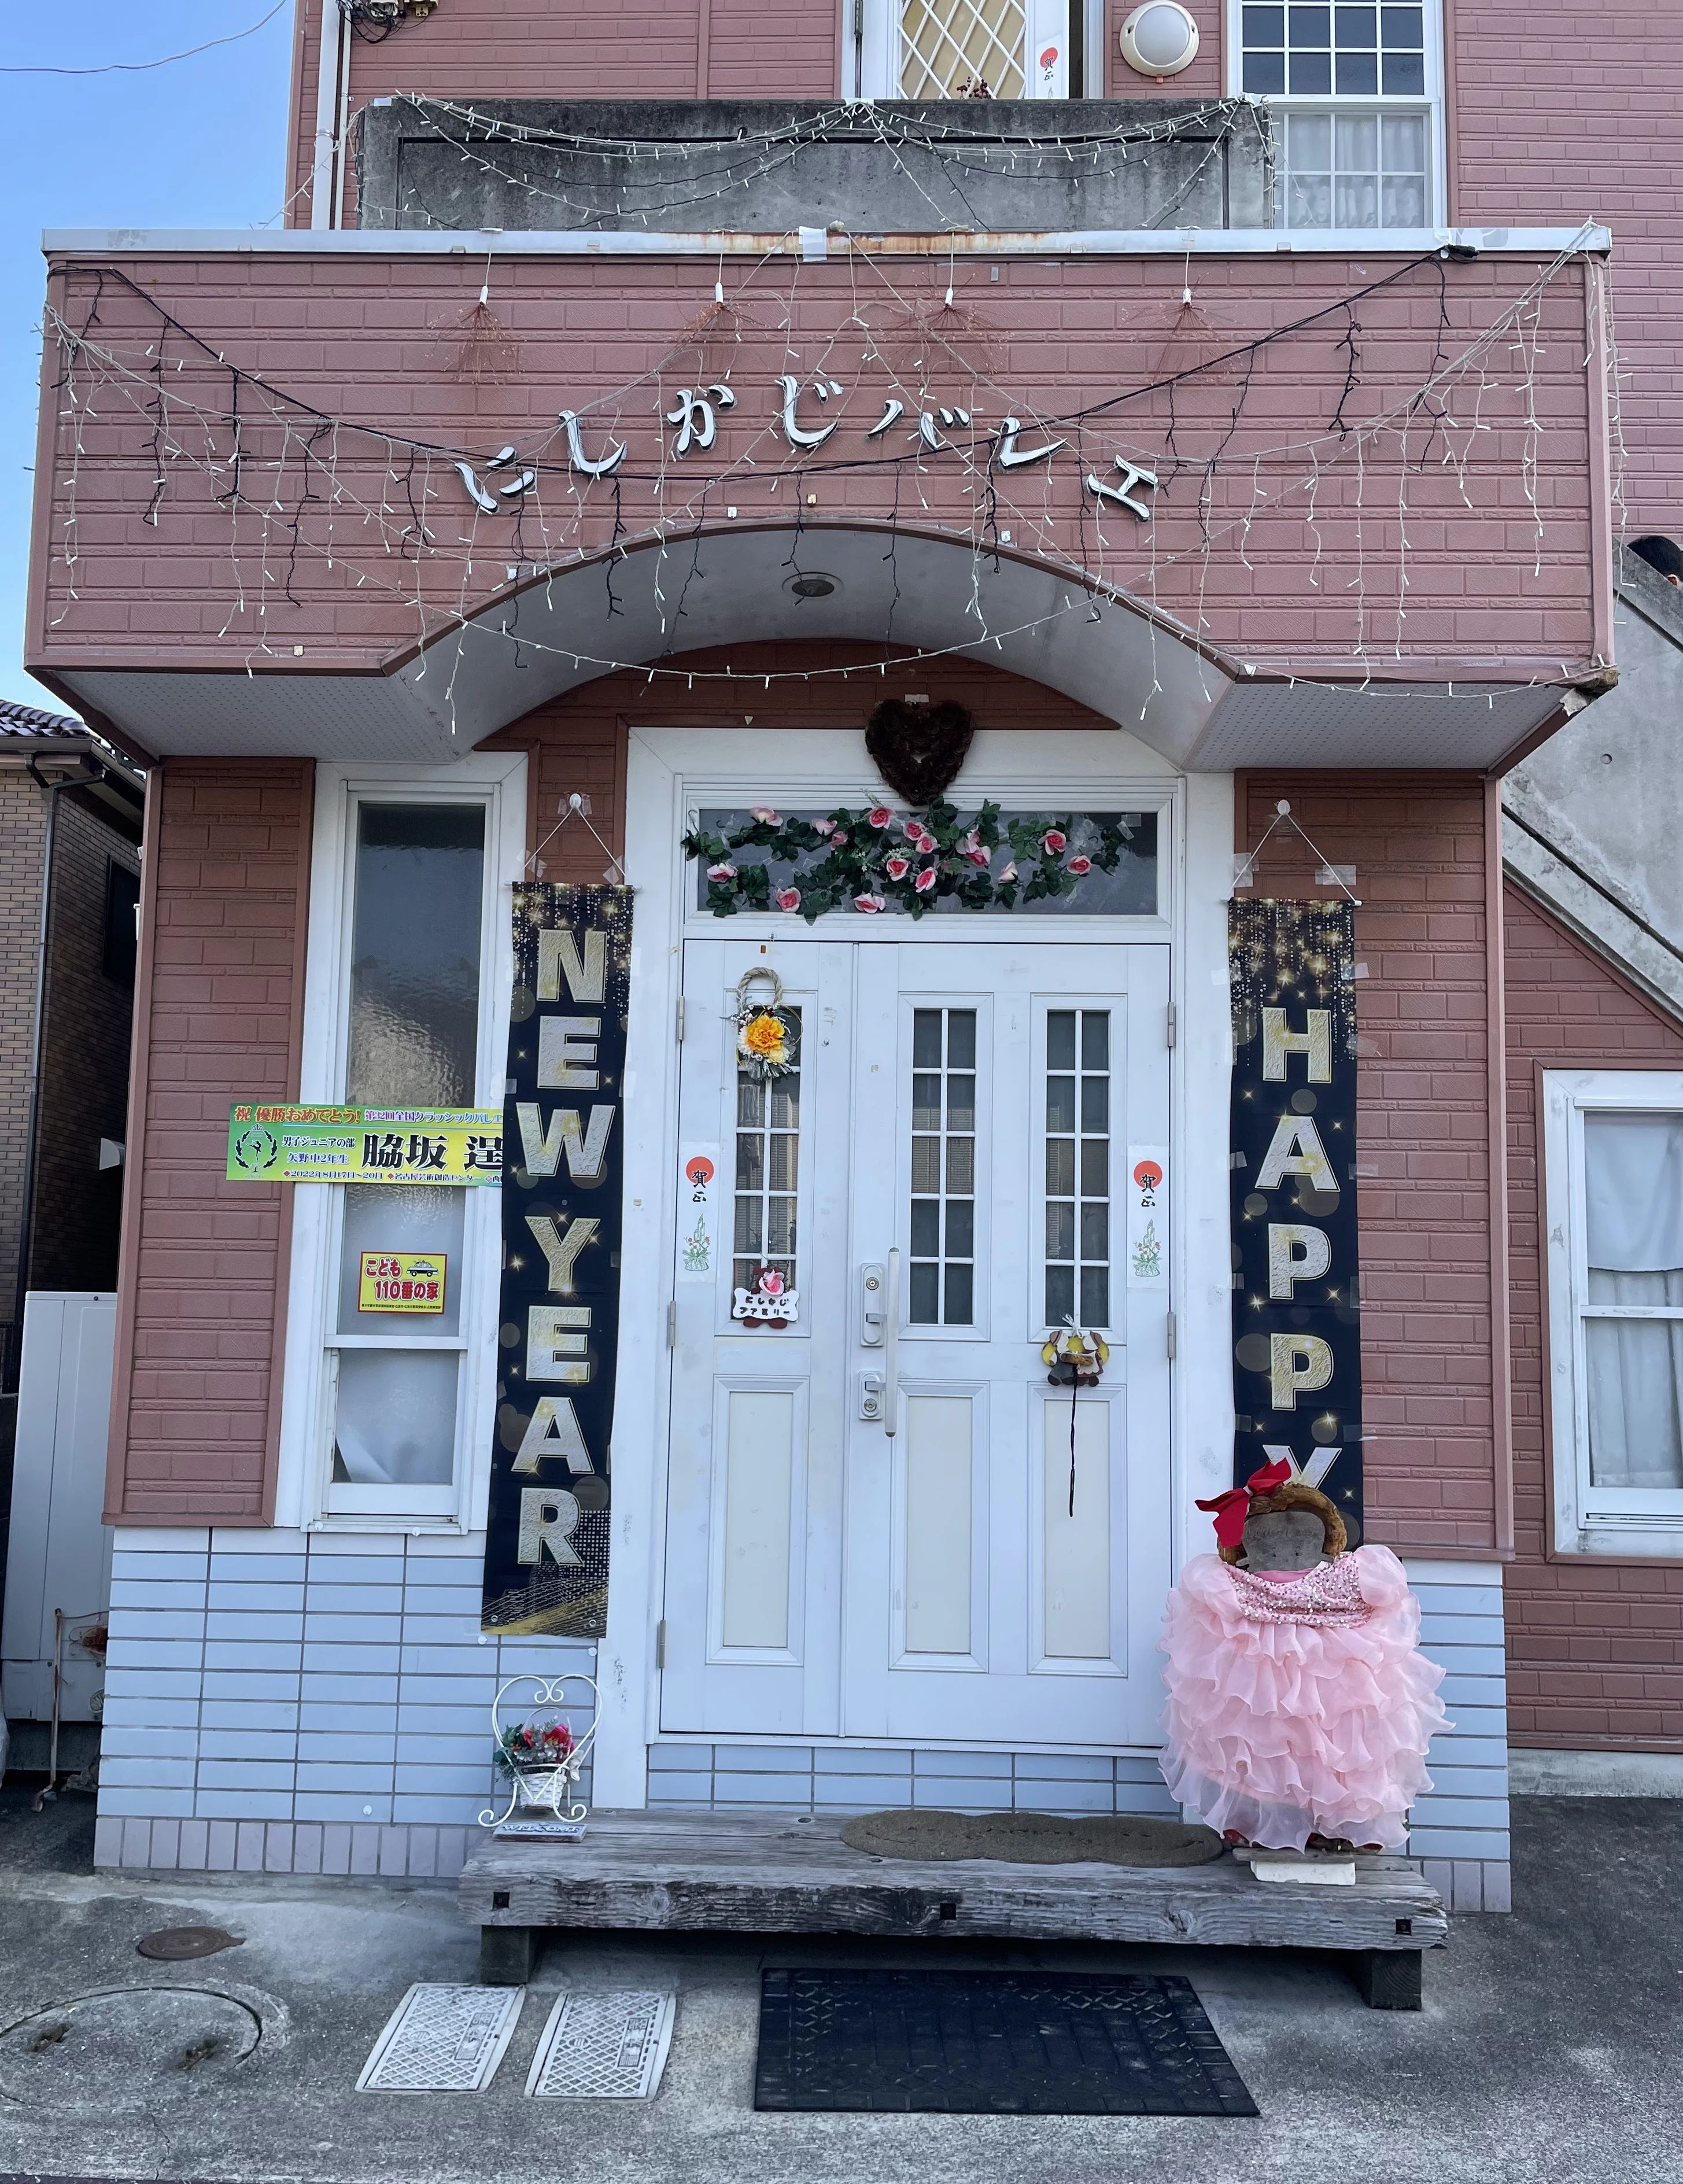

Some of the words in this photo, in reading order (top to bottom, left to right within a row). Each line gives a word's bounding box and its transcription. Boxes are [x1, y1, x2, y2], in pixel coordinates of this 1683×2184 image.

[455, 373, 1159, 522] にしかじバレエ
[515, 929, 615, 1178] NEW
[235, 1106, 252, 1122] 祝
[282, 1135, 356, 1148] 男子ジュニアの部
[361, 1133, 448, 1171] 脇坂
[288, 1153, 349, 1164] 矢野中2年生
[692, 1170, 707, 1202] 賀正
[1140, 1174, 1156, 1207] 賀正
[366, 1257, 402, 1278] こども
[375, 1279, 440, 1301] 110番の家
[740, 1307, 790, 1316] ファミリー
[745, 1296, 789, 1307] にしかじ
[511, 1216, 600, 1566] YEAR
[502, 1824, 580, 1833] WELCOME
